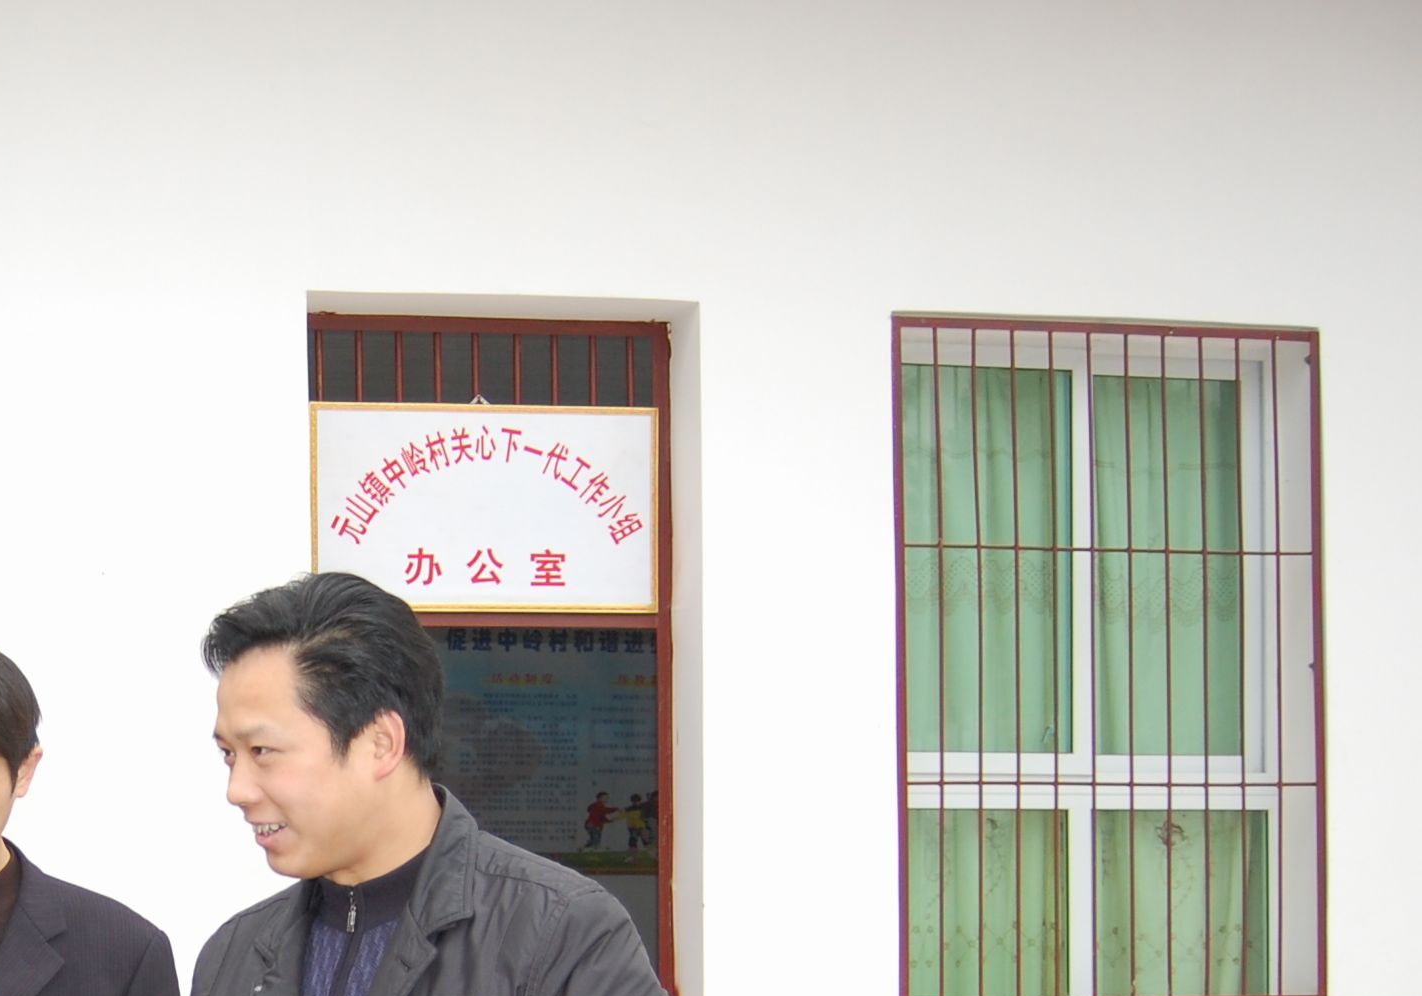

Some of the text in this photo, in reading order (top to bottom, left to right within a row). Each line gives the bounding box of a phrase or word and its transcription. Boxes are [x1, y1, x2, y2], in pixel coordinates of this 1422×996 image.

[330, 425, 644, 545] 元山镇中岭村关心下一代工作小组
[404, 547, 567, 588] 办公室
[446, 628, 657, 653] 促进中岭村和谐进
